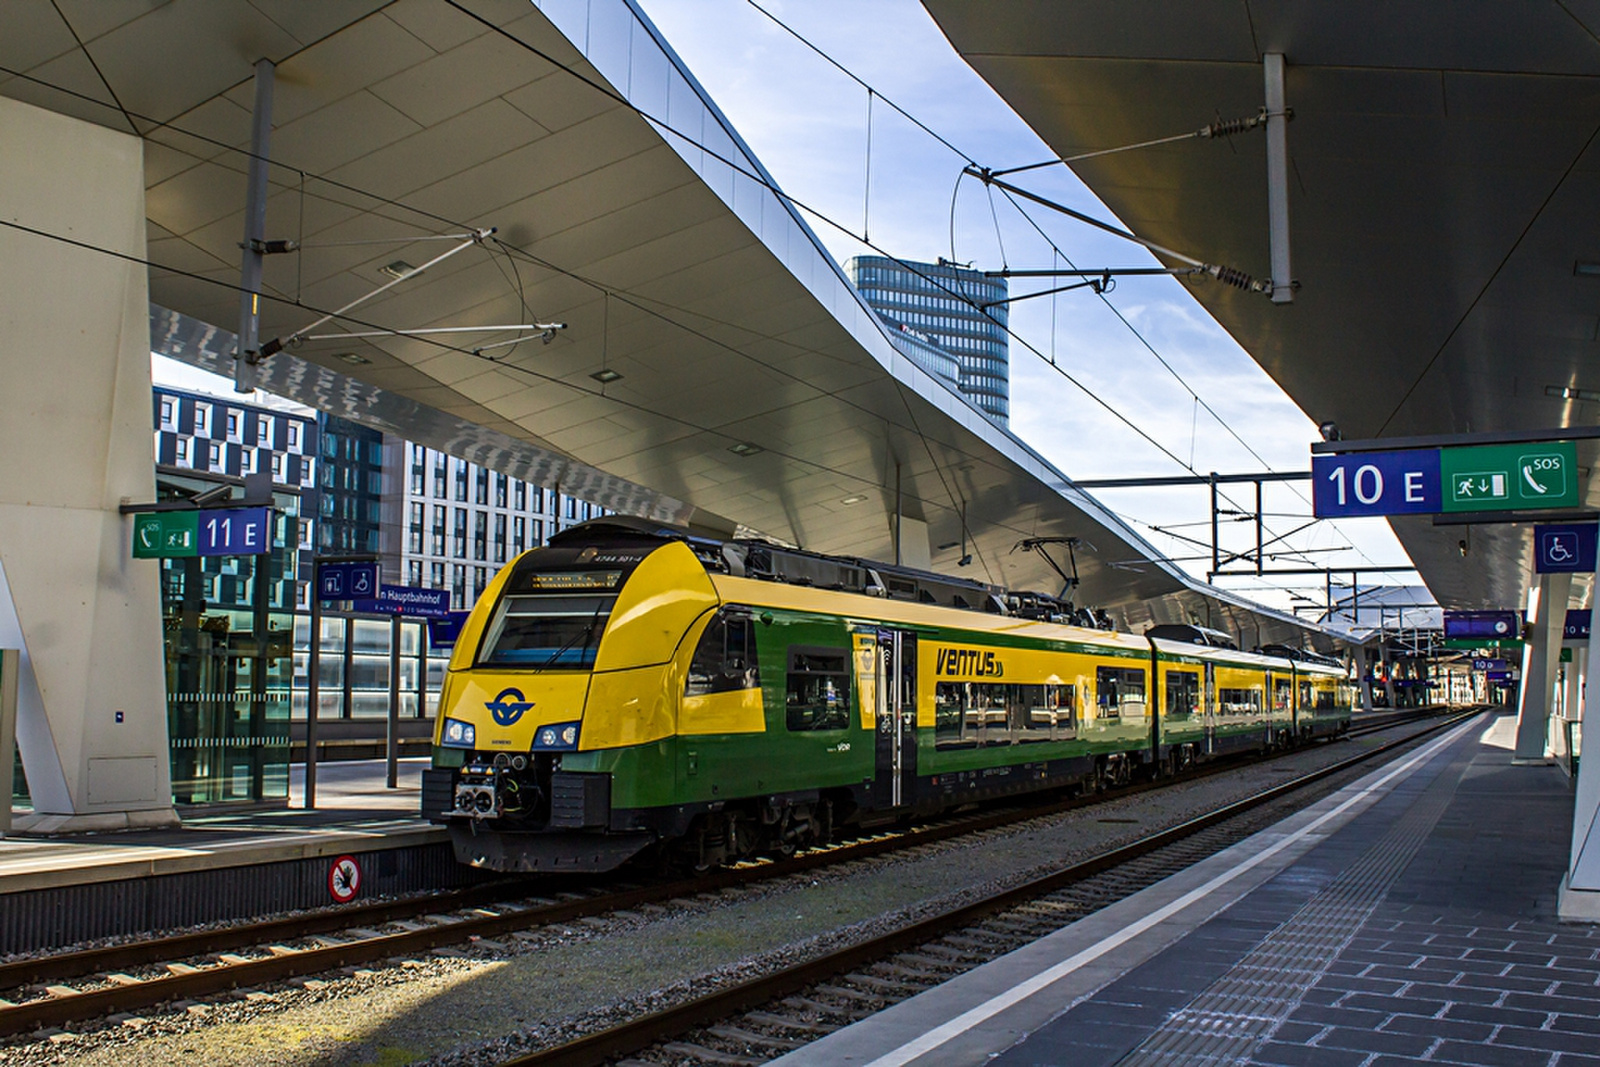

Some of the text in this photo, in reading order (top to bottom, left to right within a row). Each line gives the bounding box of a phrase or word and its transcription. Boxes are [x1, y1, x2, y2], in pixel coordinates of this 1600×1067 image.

[1533, 458, 1561, 470] SOS
[1328, 464, 1425, 505] 10 E
[146, 523, 160, 532] SOS
[206, 517, 257, 548] 11 E
[387, 590, 441, 605] Hauptbahnhof
